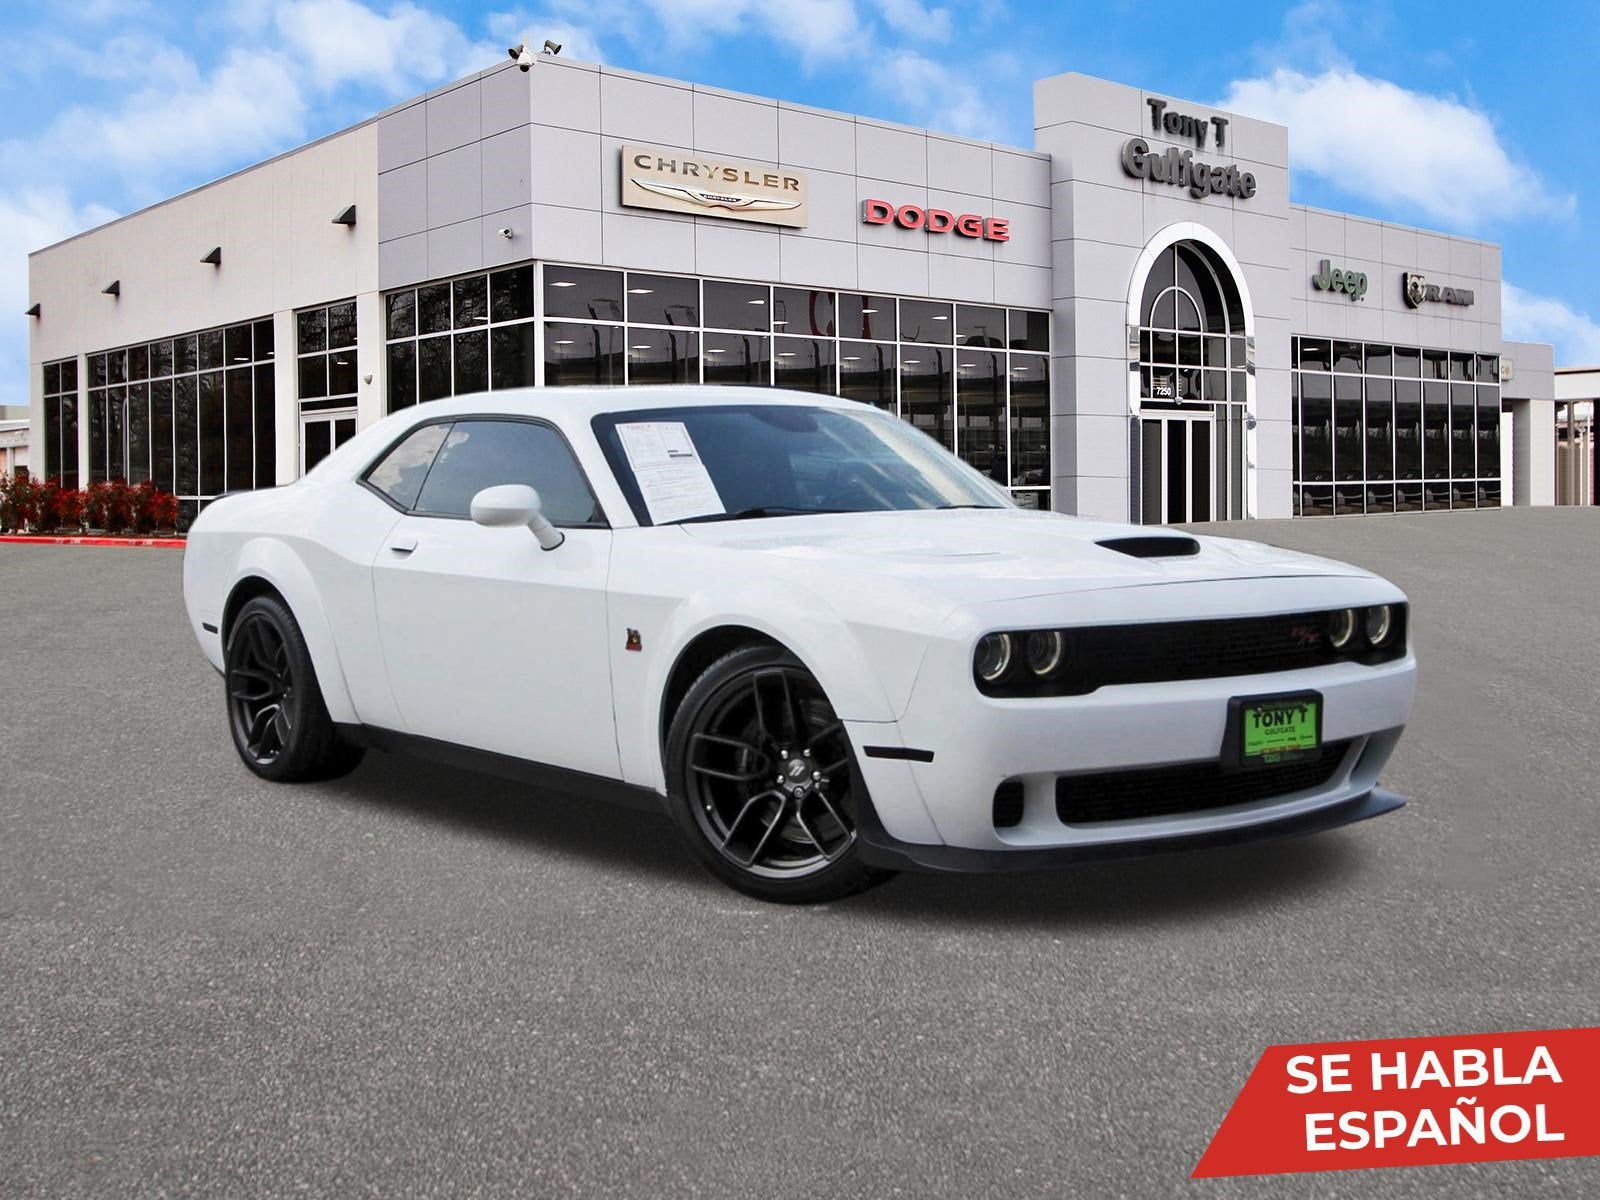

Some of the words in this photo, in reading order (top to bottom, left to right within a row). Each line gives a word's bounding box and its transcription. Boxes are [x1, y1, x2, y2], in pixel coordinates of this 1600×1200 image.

[1147, 98, 1208, 148] Tony
[1210, 116, 1229, 147] T
[633, 154, 801, 192] CHRYSLER
[1121, 137, 1257, 199] Gulfgate
[862, 198, 1011, 242] DODGE
[1312, 259, 1369, 302] Jeep
[1424, 283, 1475, 306] RAM
[1252, 709, 1294, 729] TONY
[1298, 706, 1308, 723] T
